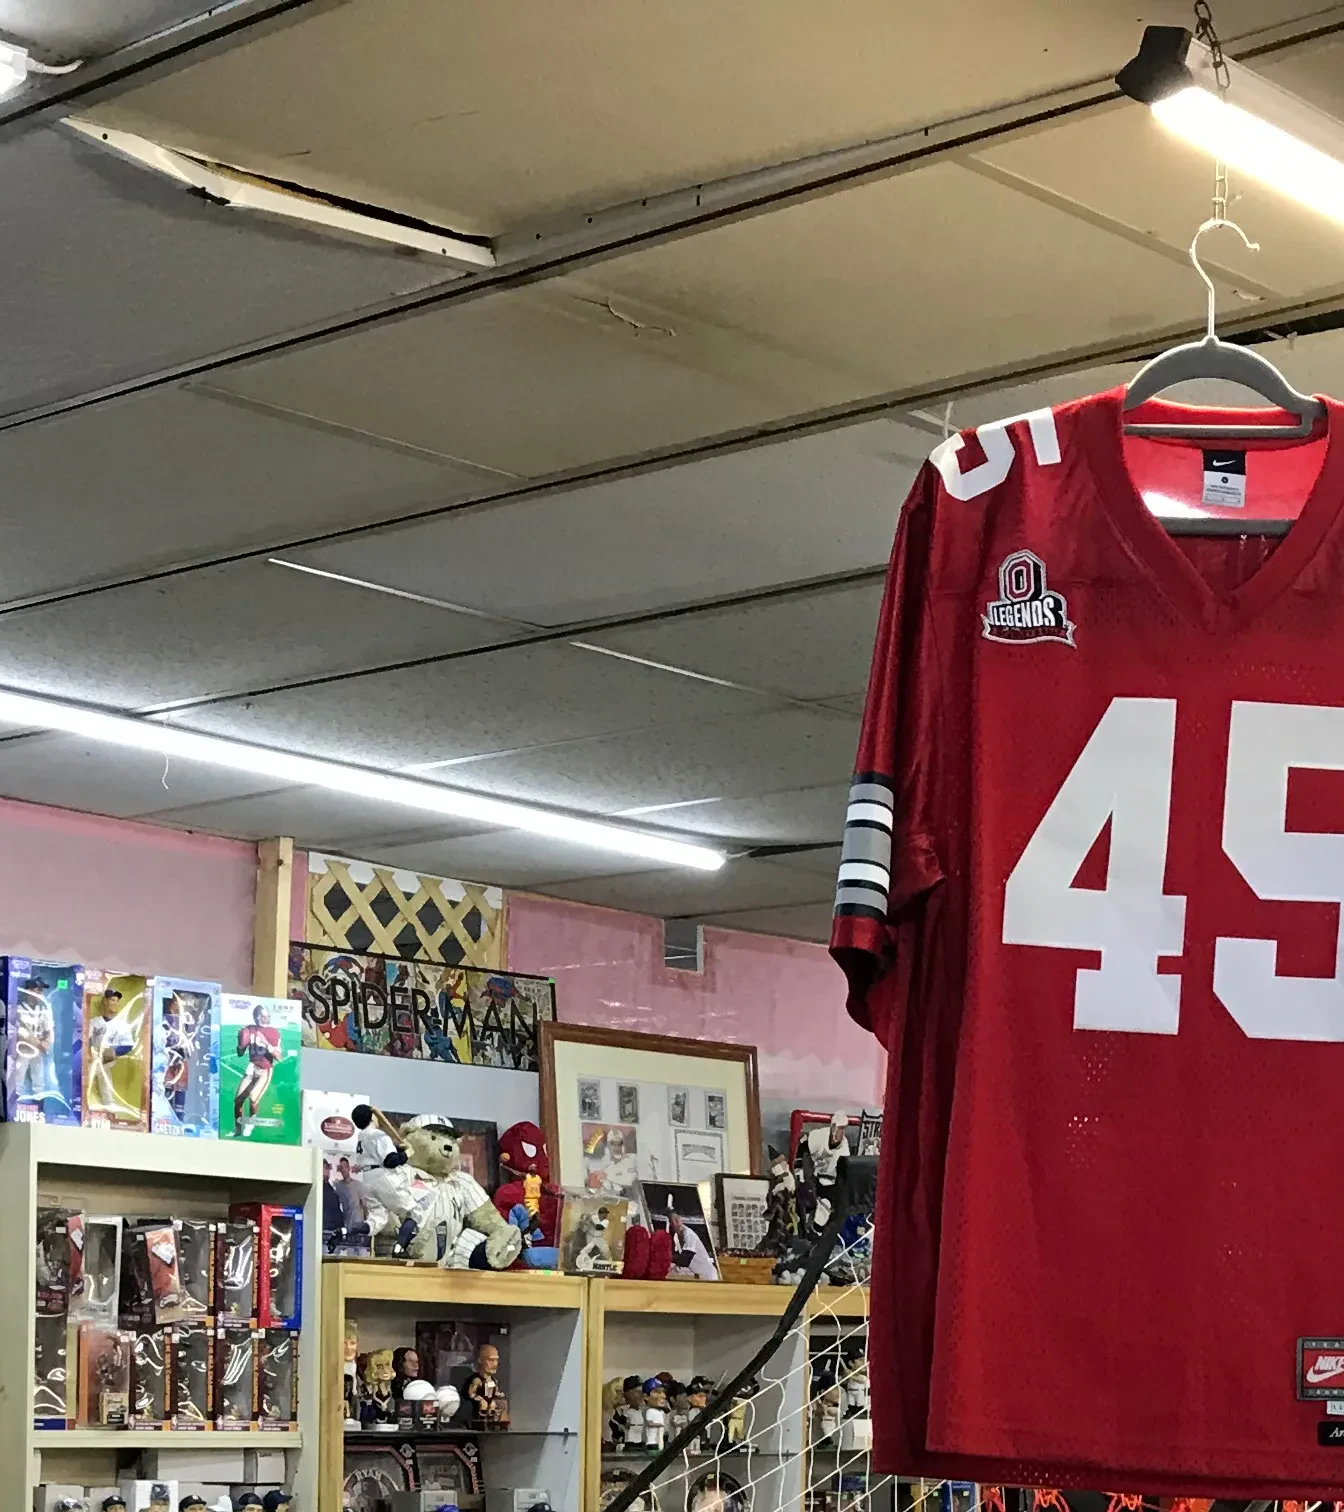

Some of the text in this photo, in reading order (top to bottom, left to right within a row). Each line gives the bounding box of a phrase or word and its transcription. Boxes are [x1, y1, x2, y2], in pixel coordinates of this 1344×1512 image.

[991, 597, 1056, 628] LEGENDS
[307, 974, 538, 1042] SPIDER-MAN
[14, 1109, 46, 1124] JONES
